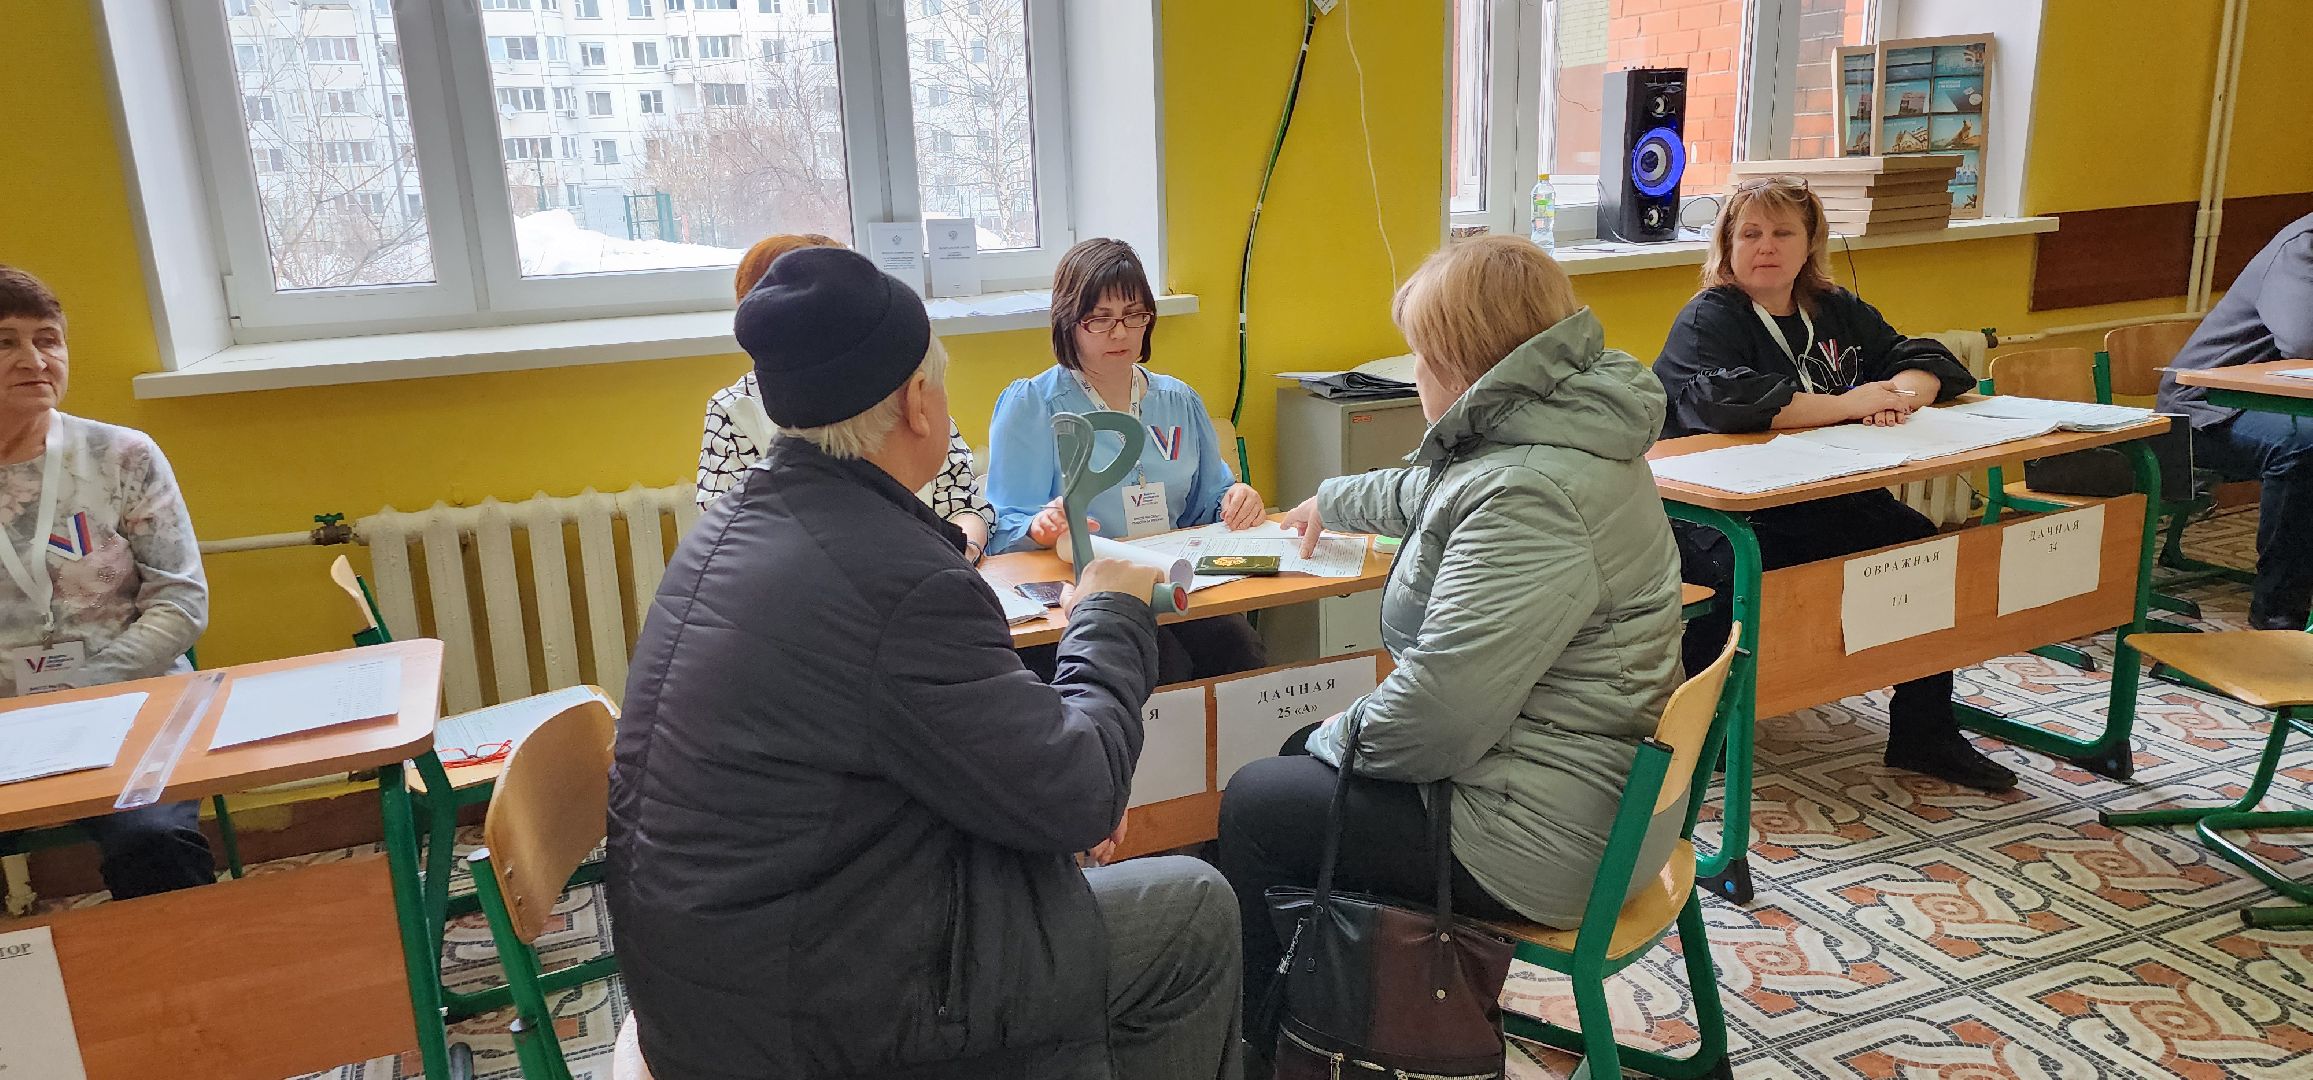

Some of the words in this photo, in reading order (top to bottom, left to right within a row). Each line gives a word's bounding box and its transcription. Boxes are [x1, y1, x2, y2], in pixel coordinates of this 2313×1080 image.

[2029, 520, 2079, 542] ДАЧНАЯ
[1863, 551, 1940, 577] ОВРАЖНАЯ
[1257, 679, 1335, 704] ДАЧНАЯ
[1277, 706, 1291, 718] 25
[1294, 704, 1318, 715] «А»
